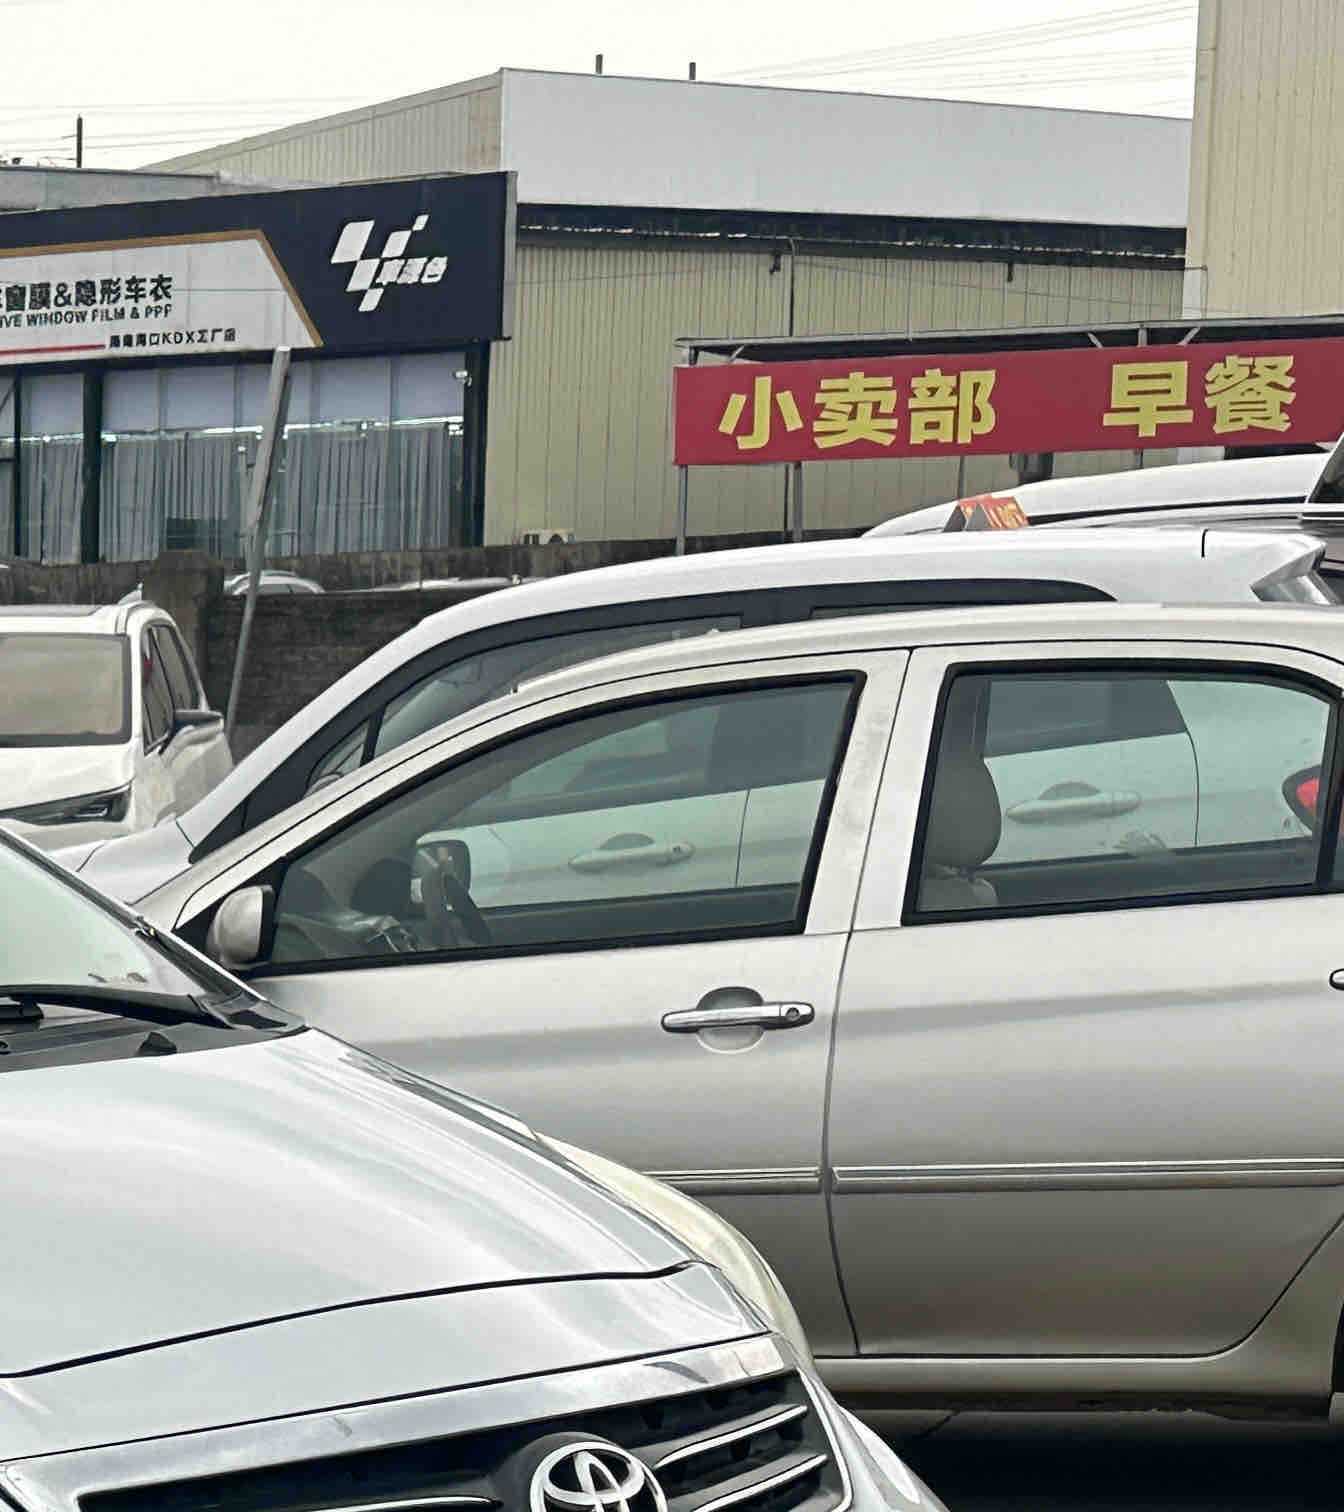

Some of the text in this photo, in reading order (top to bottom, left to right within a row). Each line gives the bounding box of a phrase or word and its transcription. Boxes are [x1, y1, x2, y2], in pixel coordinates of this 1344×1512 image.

[26, 309, 87, 327] WINDOW
[92, 306, 126, 322] FILM
[718, 354, 1298, 450] 小卖部 早餐
